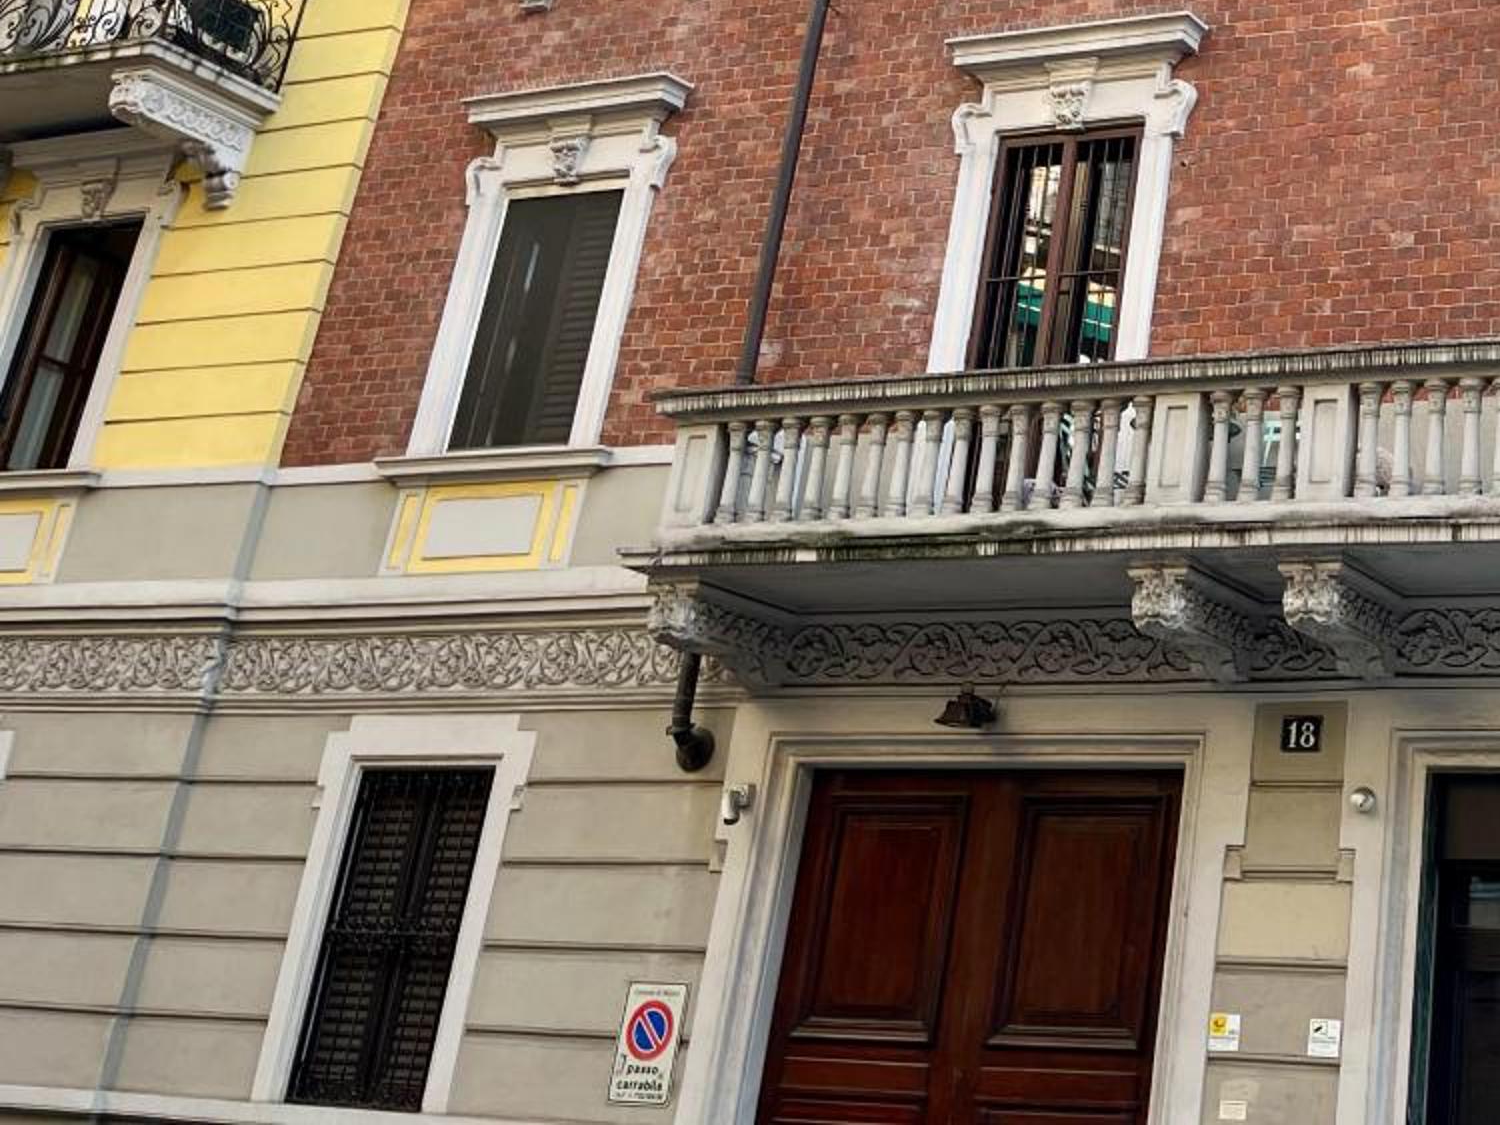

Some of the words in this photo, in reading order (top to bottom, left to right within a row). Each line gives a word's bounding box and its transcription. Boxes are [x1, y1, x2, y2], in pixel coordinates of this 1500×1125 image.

[1288, 721, 1315, 748] 18
[626, 1064, 659, 1075] passo
[616, 1080, 663, 1091] carrabile
